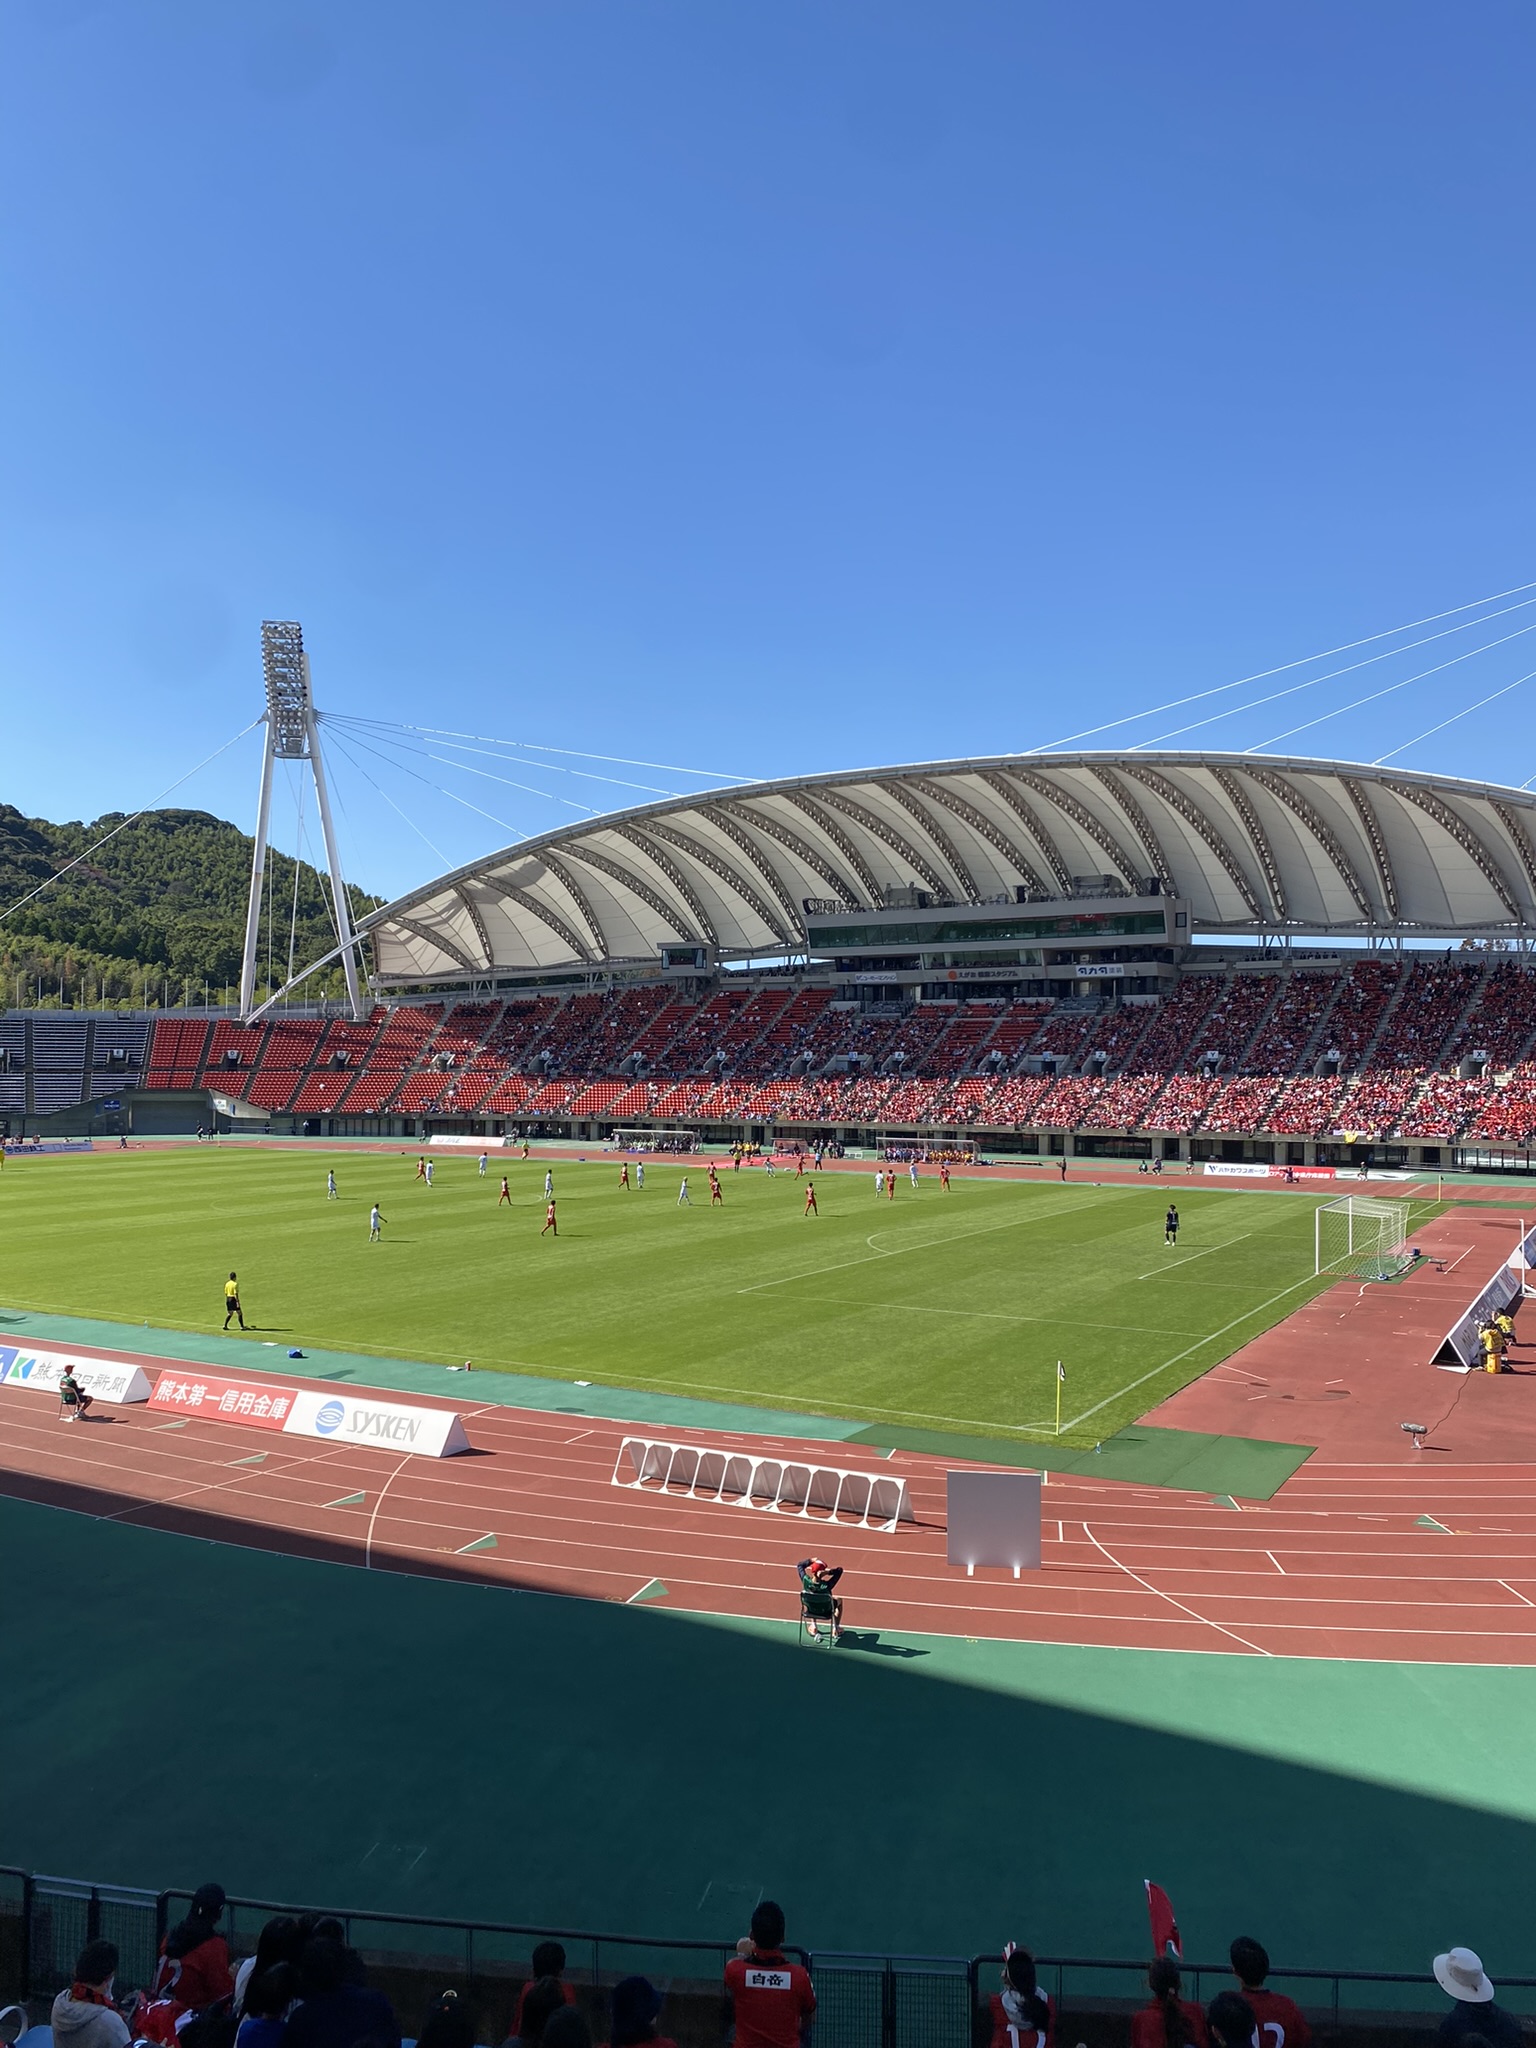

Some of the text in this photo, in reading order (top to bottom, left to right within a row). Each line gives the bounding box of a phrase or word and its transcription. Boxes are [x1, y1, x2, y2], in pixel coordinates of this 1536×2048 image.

[154, 1379, 291, 1420] 熊本第一信用金庫
[346, 1410, 422, 1443] SYSKEN
[752, 1973, 784, 1986] 白岳
